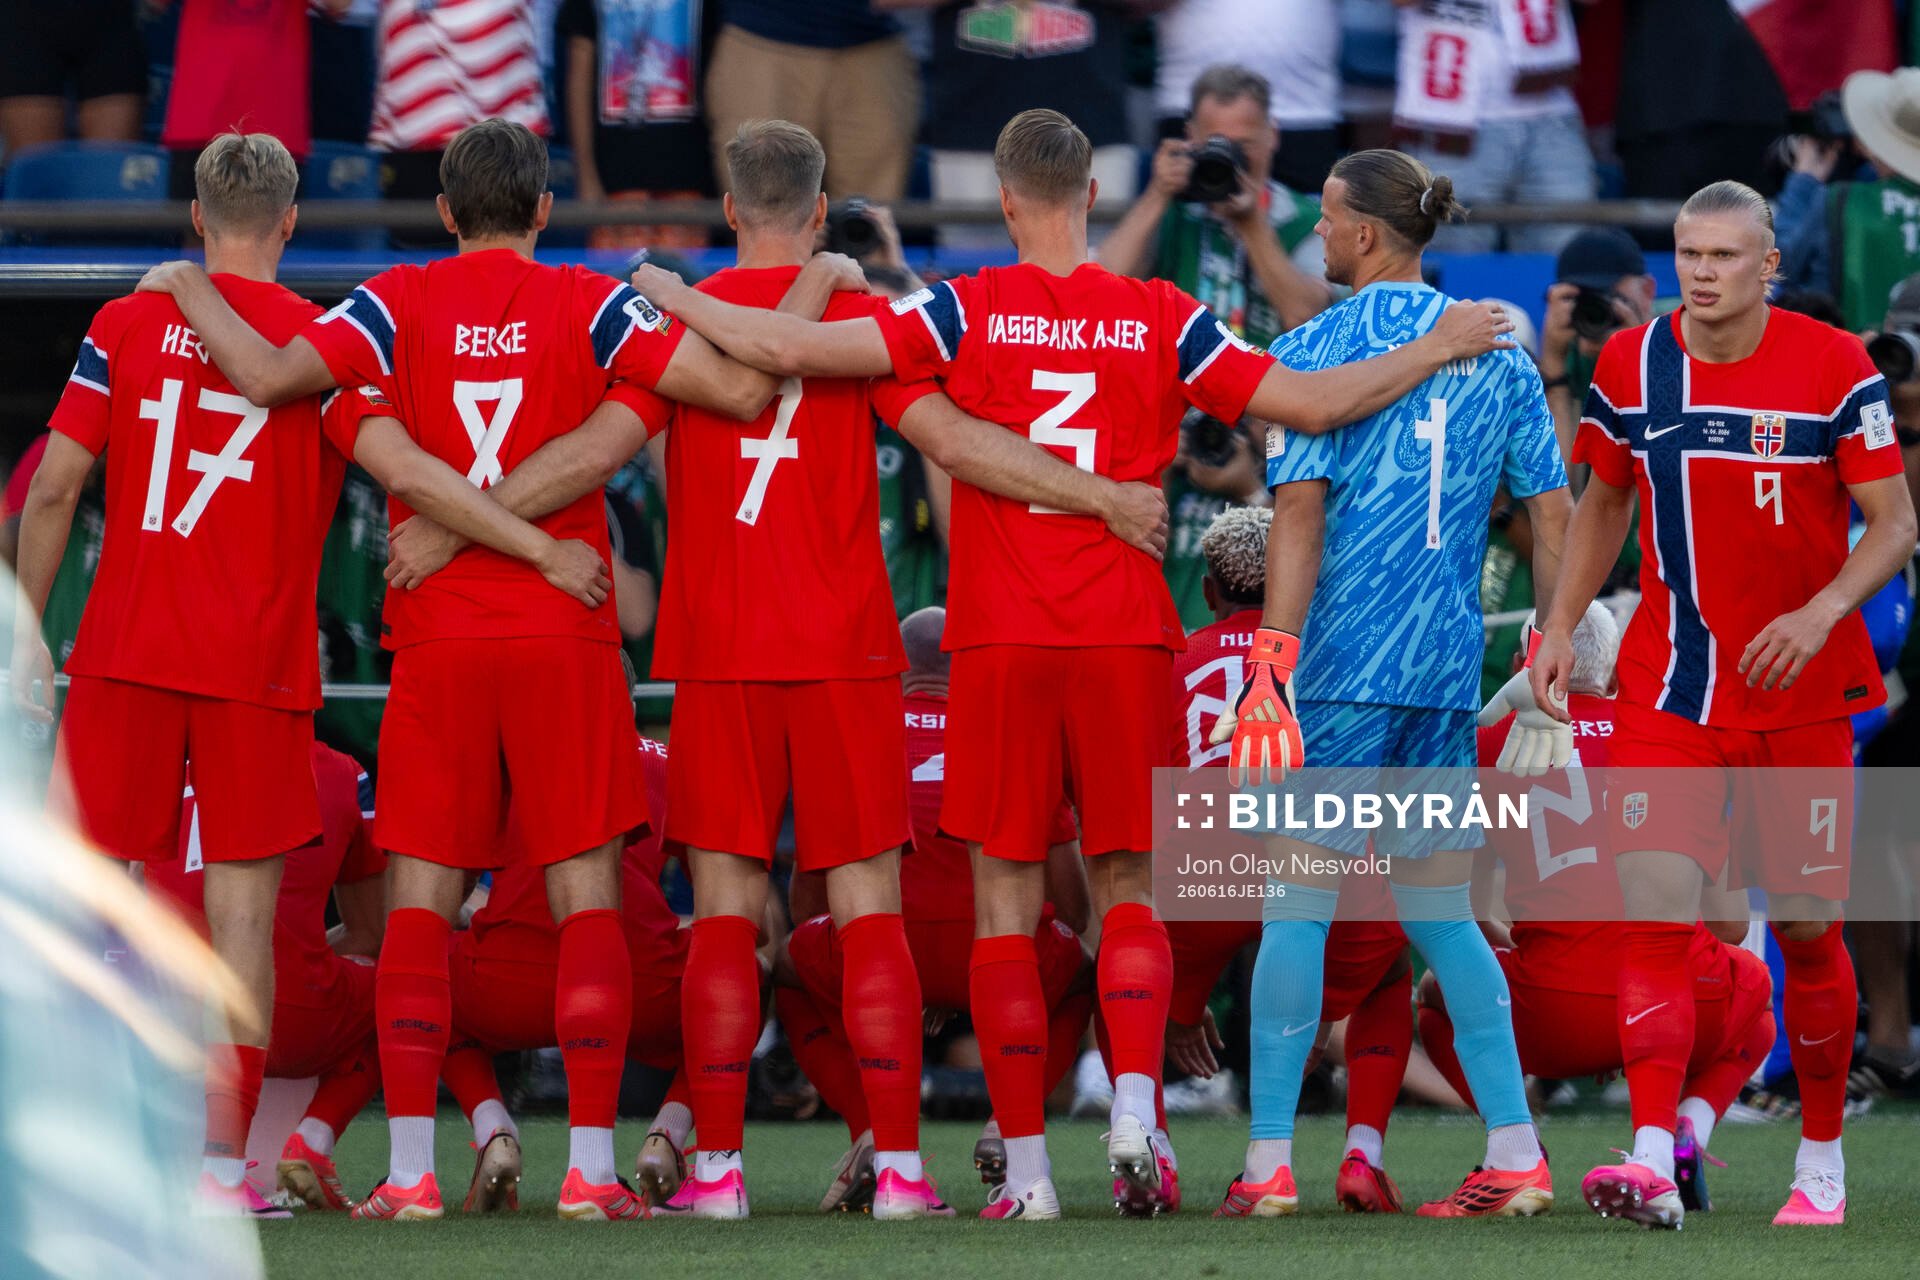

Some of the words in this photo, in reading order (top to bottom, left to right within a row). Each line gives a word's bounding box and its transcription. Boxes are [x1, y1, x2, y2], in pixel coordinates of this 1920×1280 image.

[454, 321, 527, 357] BERGE
[1092, 319, 1148, 352] AJER
[138, 377, 270, 539] 17
[453, 378, 523, 489] 8
[735, 377, 803, 526] 7
[1029, 369, 1097, 515] 3
[1415, 398, 1447, 550] 1
[1754, 471, 1784, 525] 9
[638, 737, 668, 759] FE
[1809, 798, 1838, 853] 9
